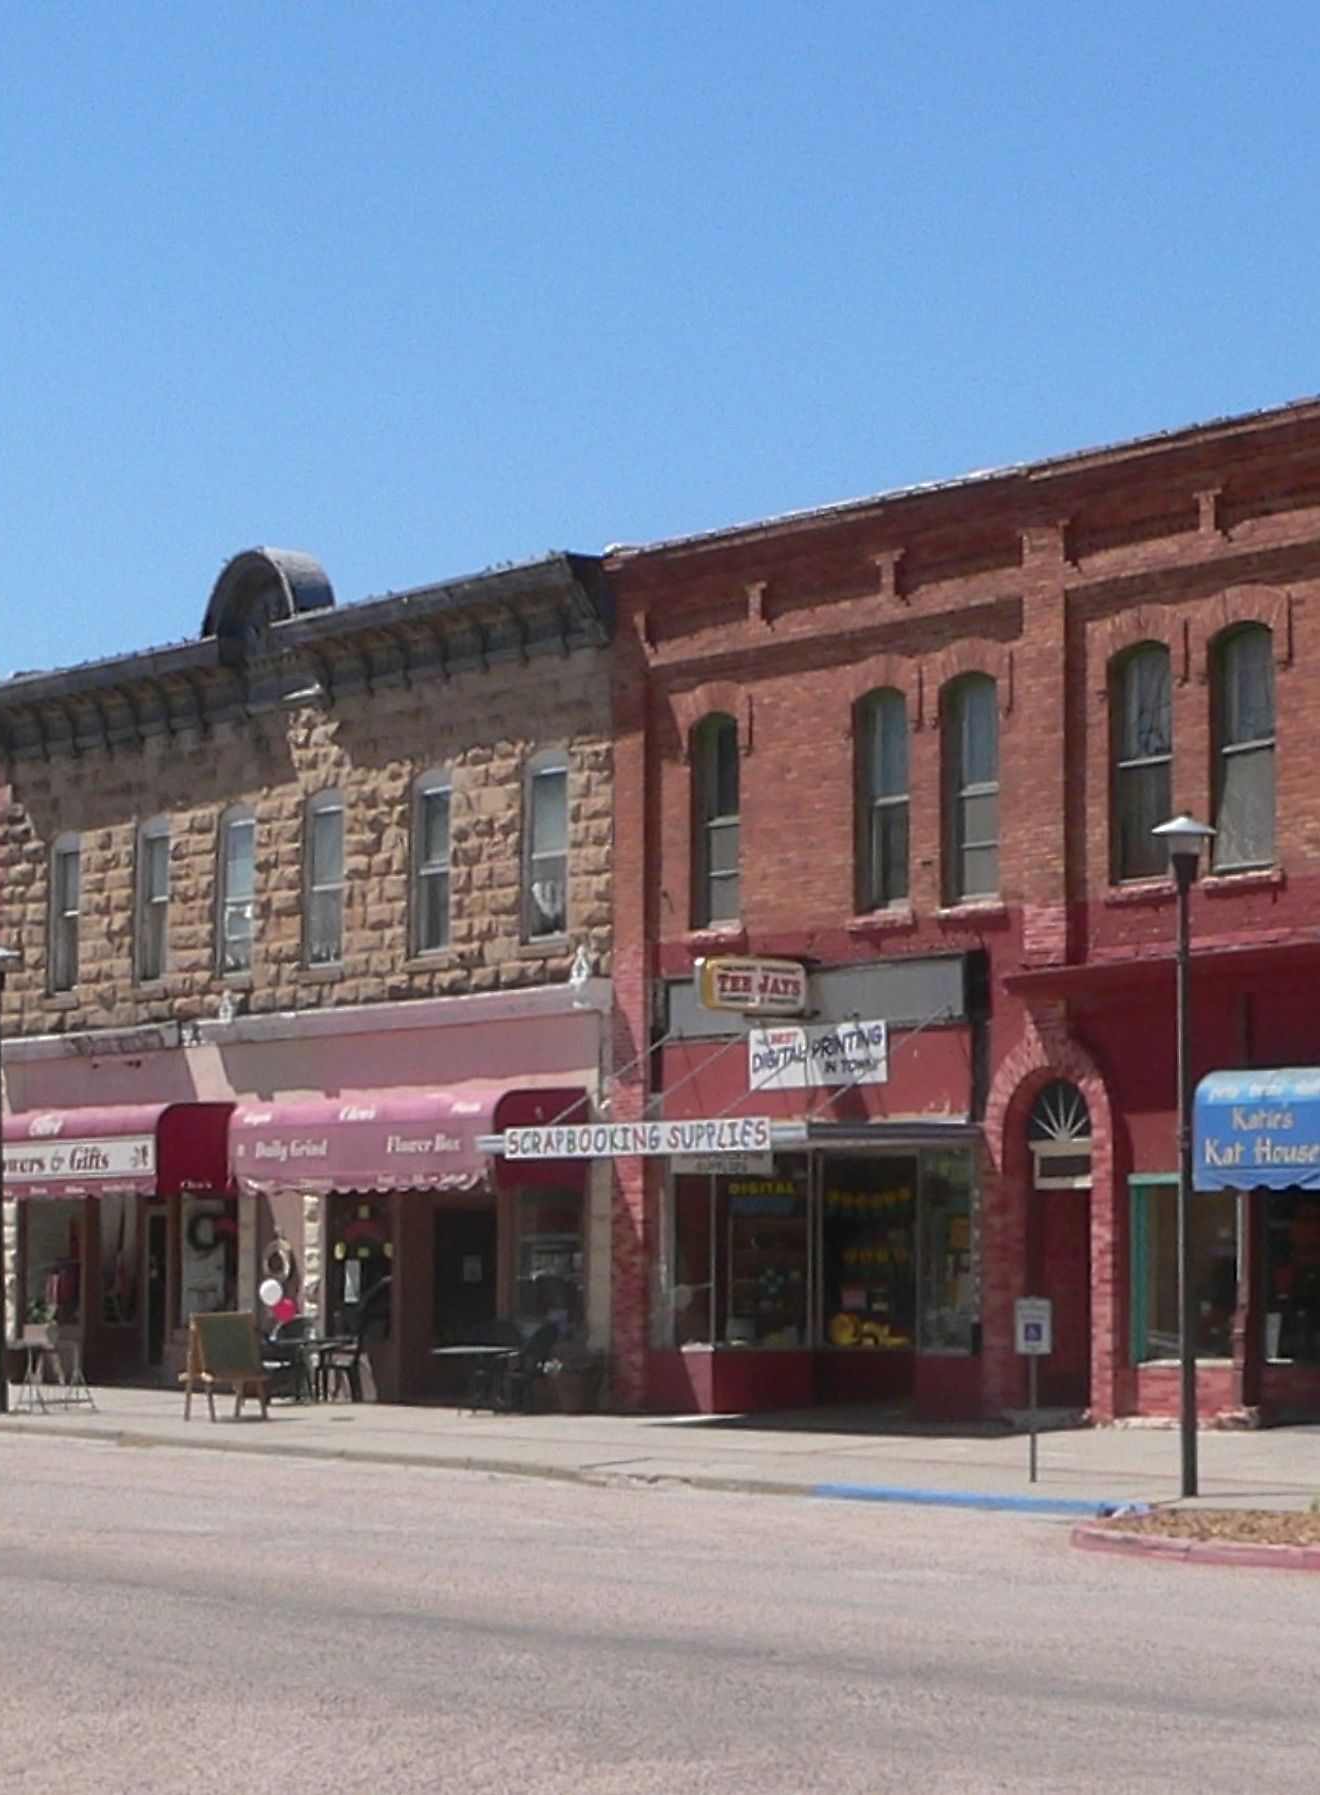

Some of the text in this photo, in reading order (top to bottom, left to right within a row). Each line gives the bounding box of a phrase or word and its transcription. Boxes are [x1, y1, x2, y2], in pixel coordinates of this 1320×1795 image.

[752, 1024, 884, 1073] DIGITAL PRINTING
[290, 1139, 328, 1157] Grind
[386, 1134, 461, 1154] Flower Box
[507, 1119, 768, 1156] SCRAPBOOKING SUPPLIES
[69, 1145, 110, 1171] Gifts
[1204, 1138, 1245, 1166] Kat
